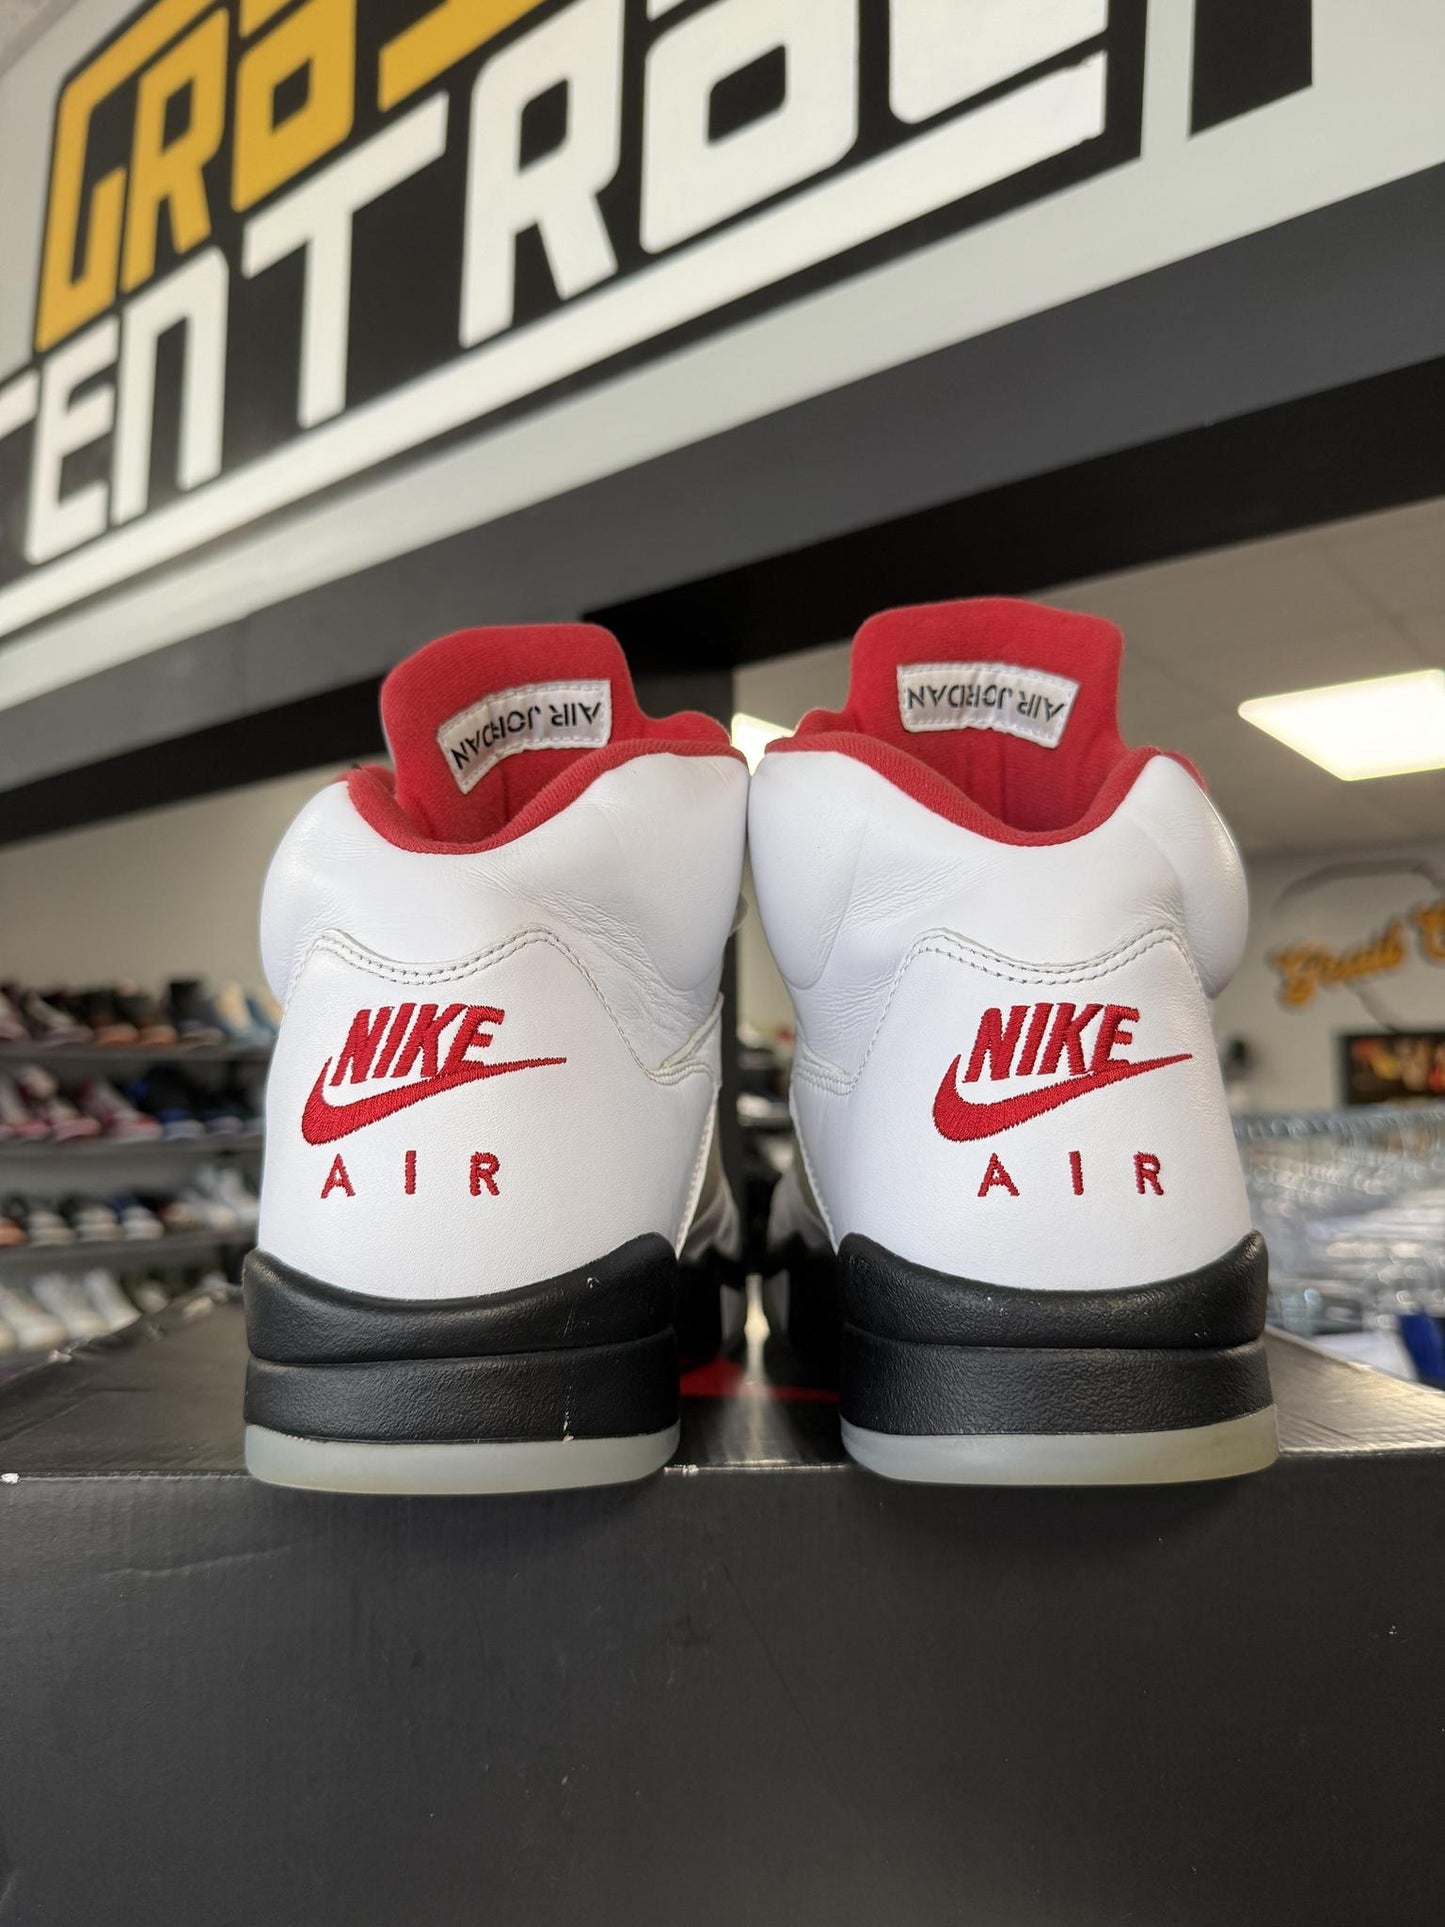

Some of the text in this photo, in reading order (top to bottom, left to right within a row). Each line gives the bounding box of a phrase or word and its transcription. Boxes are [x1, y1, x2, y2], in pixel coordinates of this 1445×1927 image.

[906, 683, 1065, 722] AIR JORDAN
[450, 702, 602, 770] AIR JORDAN
[328, 1001, 505, 1087] NIKE
[961, 1001, 1141, 1084] NIKE
[320, 1150, 501, 1199] AIR
[977, 1150, 1165, 1198] AIR
